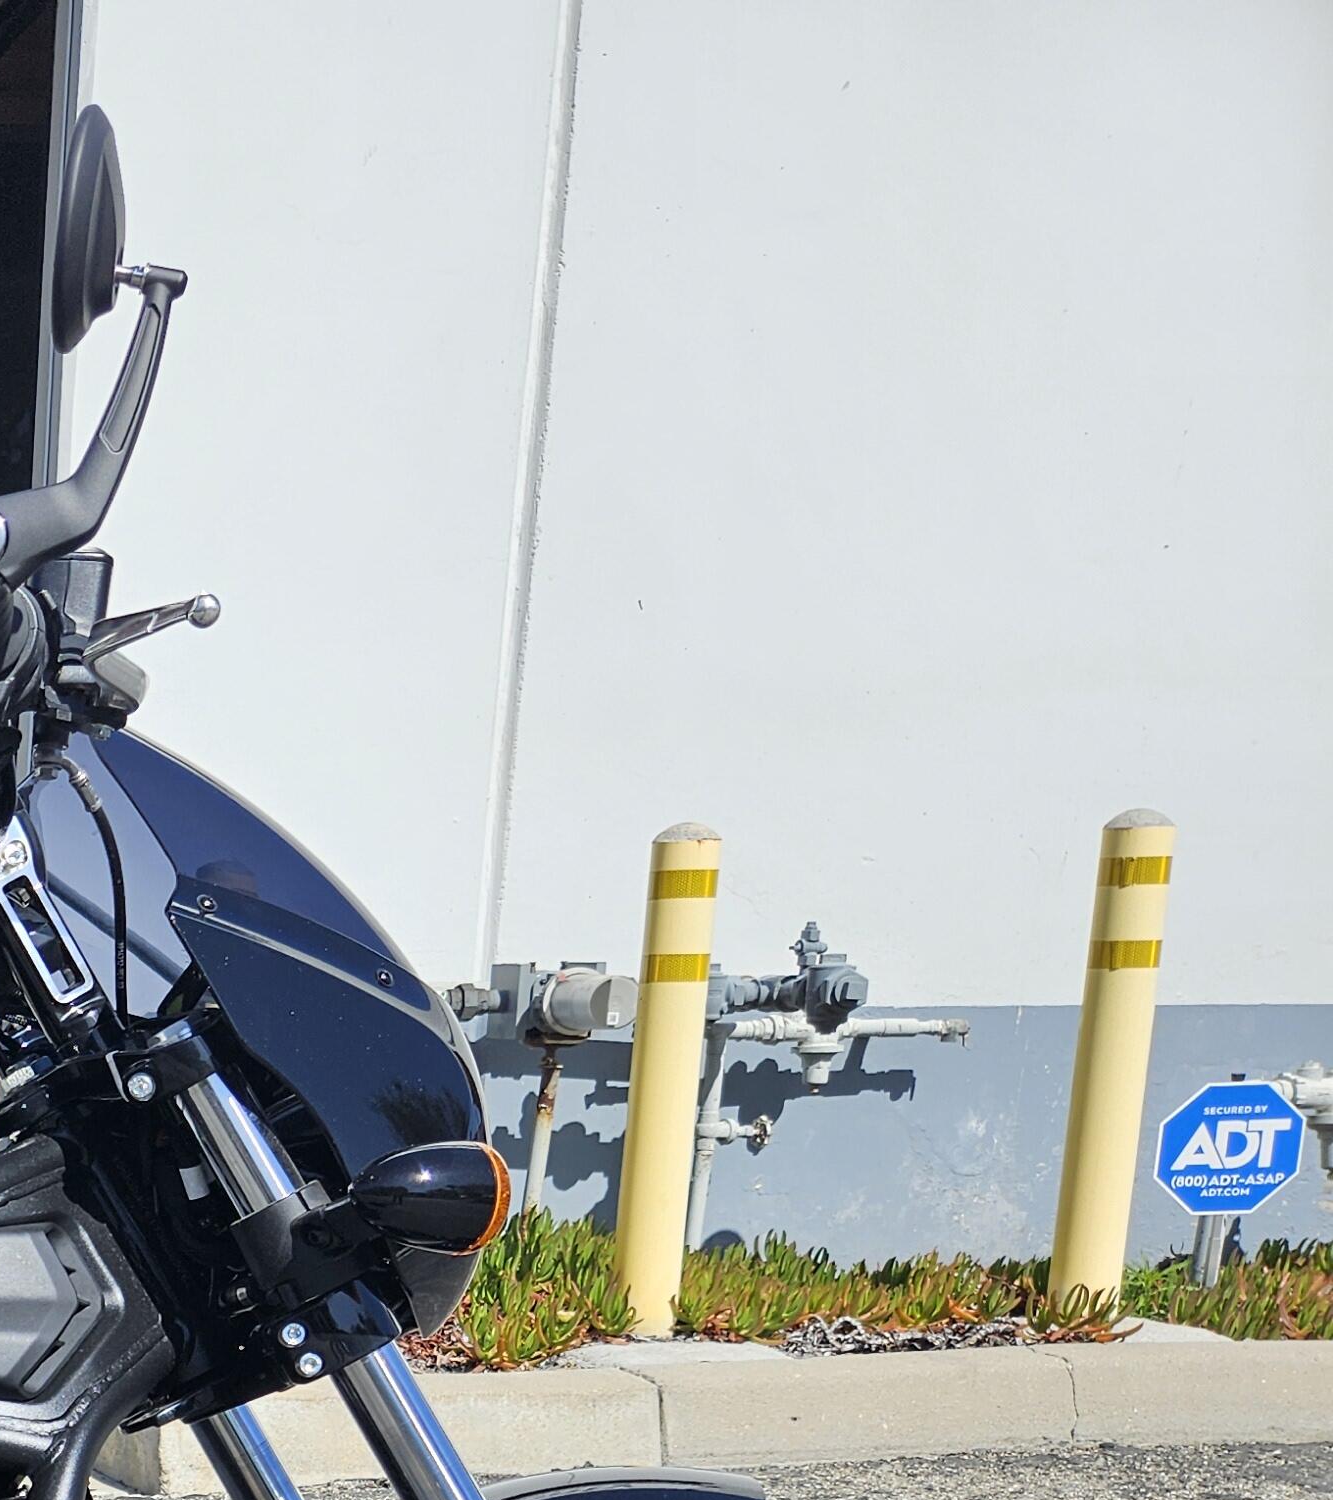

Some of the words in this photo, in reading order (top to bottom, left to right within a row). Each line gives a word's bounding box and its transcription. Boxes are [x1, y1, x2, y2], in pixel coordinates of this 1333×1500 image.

[1203, 1106, 1252, 1116] SECURED
[1254, 1105, 1269, 1114] BY
[1170, 1118, 1292, 1171] ADT
[1170, 1175, 1207, 1189] (800)
[1208, 1172, 1286, 1188] ADT-ASAP
[1200, 1187, 1250, 1197] ADT.COM
